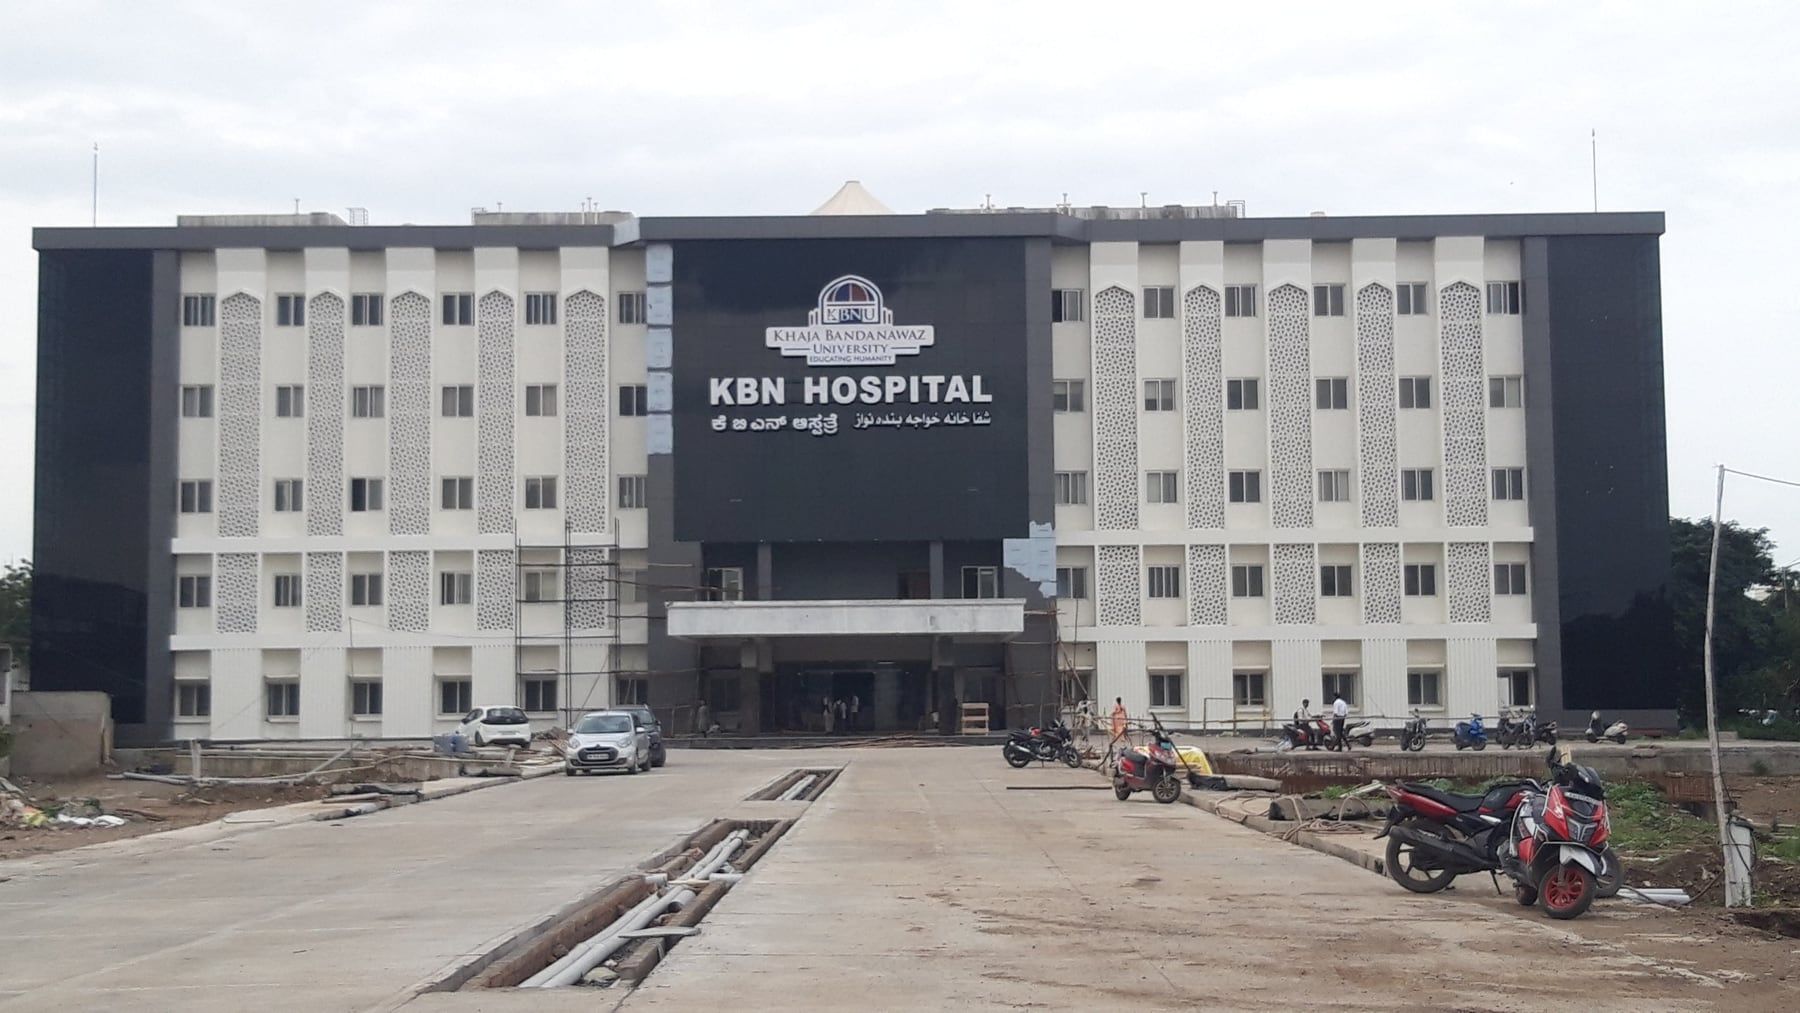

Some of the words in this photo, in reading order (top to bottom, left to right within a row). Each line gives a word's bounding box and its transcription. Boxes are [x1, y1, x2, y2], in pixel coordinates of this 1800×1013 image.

[827, 308, 876, 321] KBNU
[710, 377, 785, 405] KBN
[804, 375, 993, 404] HOSPITAL
